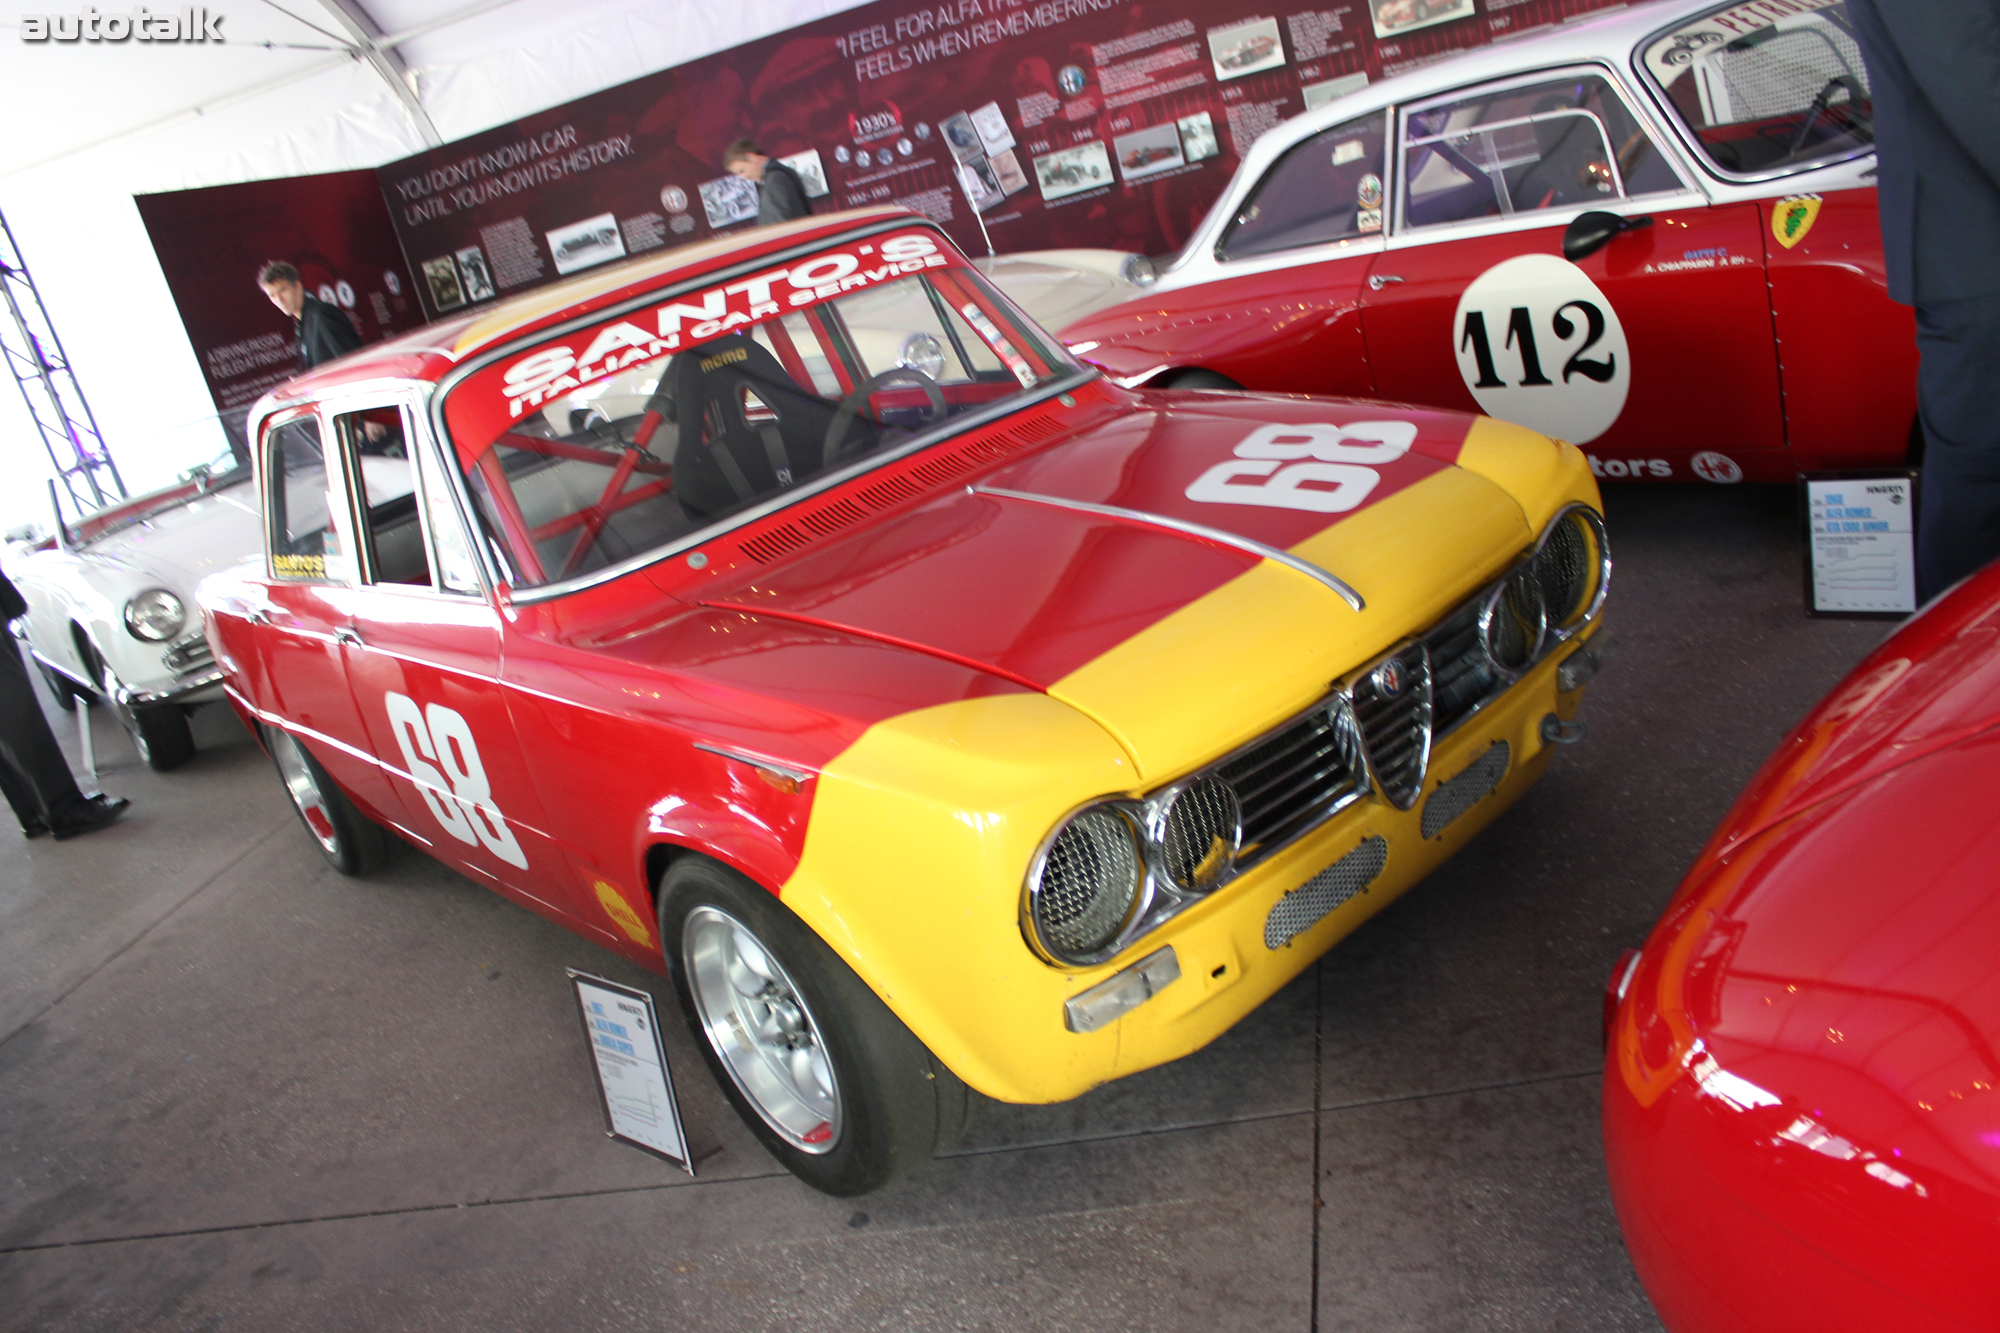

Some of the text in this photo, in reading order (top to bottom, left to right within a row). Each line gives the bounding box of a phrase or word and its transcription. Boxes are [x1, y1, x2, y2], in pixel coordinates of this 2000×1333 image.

[849, 23, 894, 54] FEEL
[895, 8, 934, 41] FOR
[935, 0, 985, 29] ALFA
[855, 44, 912, 82] FEELS
[911, 33, 971, 64] WHEN
[395, 176, 433, 202] YOU
[478, 142, 530, 175] KNOW
[529, 136, 544, 157] A
[541, 123, 579, 154] CAR
[854, 111, 898, 136] 1930's
[404, 133, 635, 227] UNTIL YOU KNOW ITS HISTORY.
[502, 234, 938, 398] SANTO'S
[509, 252, 948, 418] ITALIAN CAR SERVICE
[1461, 300, 1616, 389] 112
[1184, 420, 1418, 513] 68
[385, 690, 529, 870] 68
[605, 901, 643, 930] SHELL
